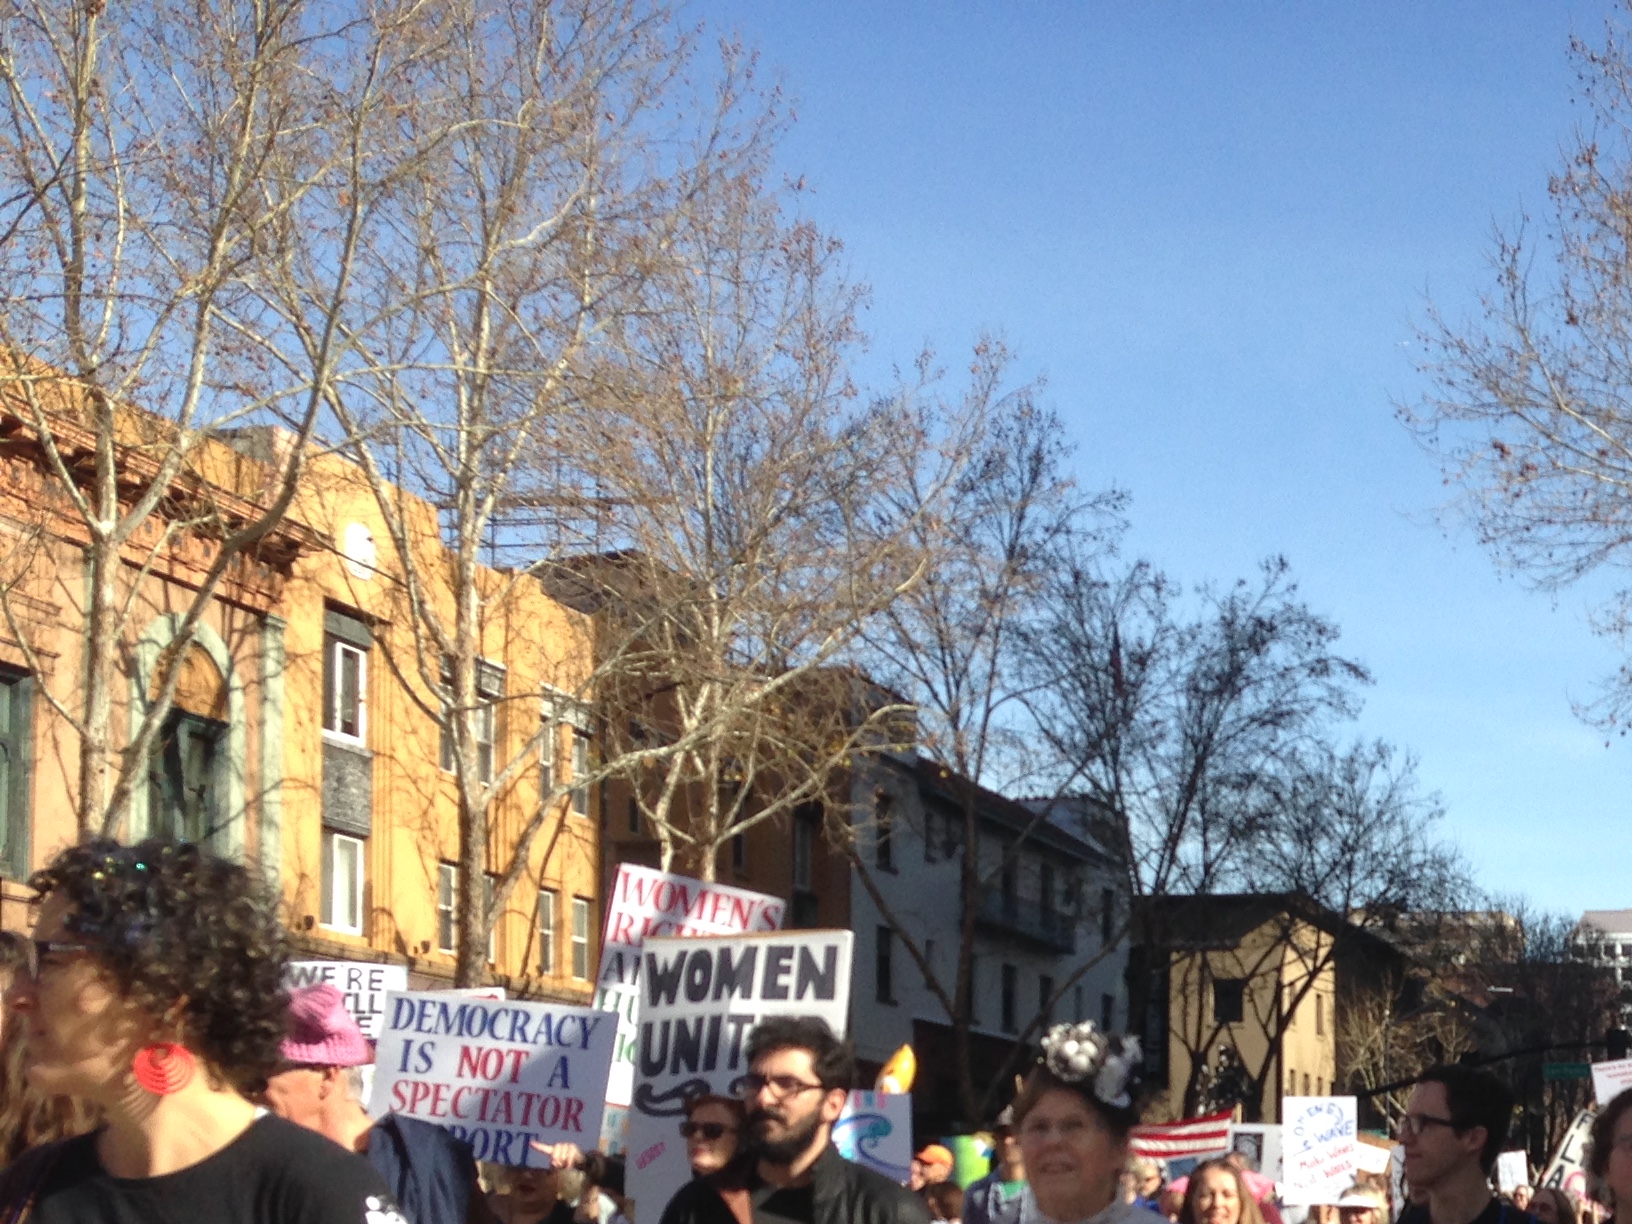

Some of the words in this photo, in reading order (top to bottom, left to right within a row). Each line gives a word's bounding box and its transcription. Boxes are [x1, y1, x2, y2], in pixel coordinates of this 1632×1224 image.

[617, 871, 780, 931] WOMEN'S
[645, 945, 838, 1008] WOMEN
[390, 997, 600, 1050] DEMOCRACY
[640, 1013, 832, 1077] UNIT
[399, 1039, 436, 1073] IS
[456, 1045, 530, 1084] NOT
[547, 1054, 570, 1090] A
[388, 1079, 585, 1133] SPECTATOR
